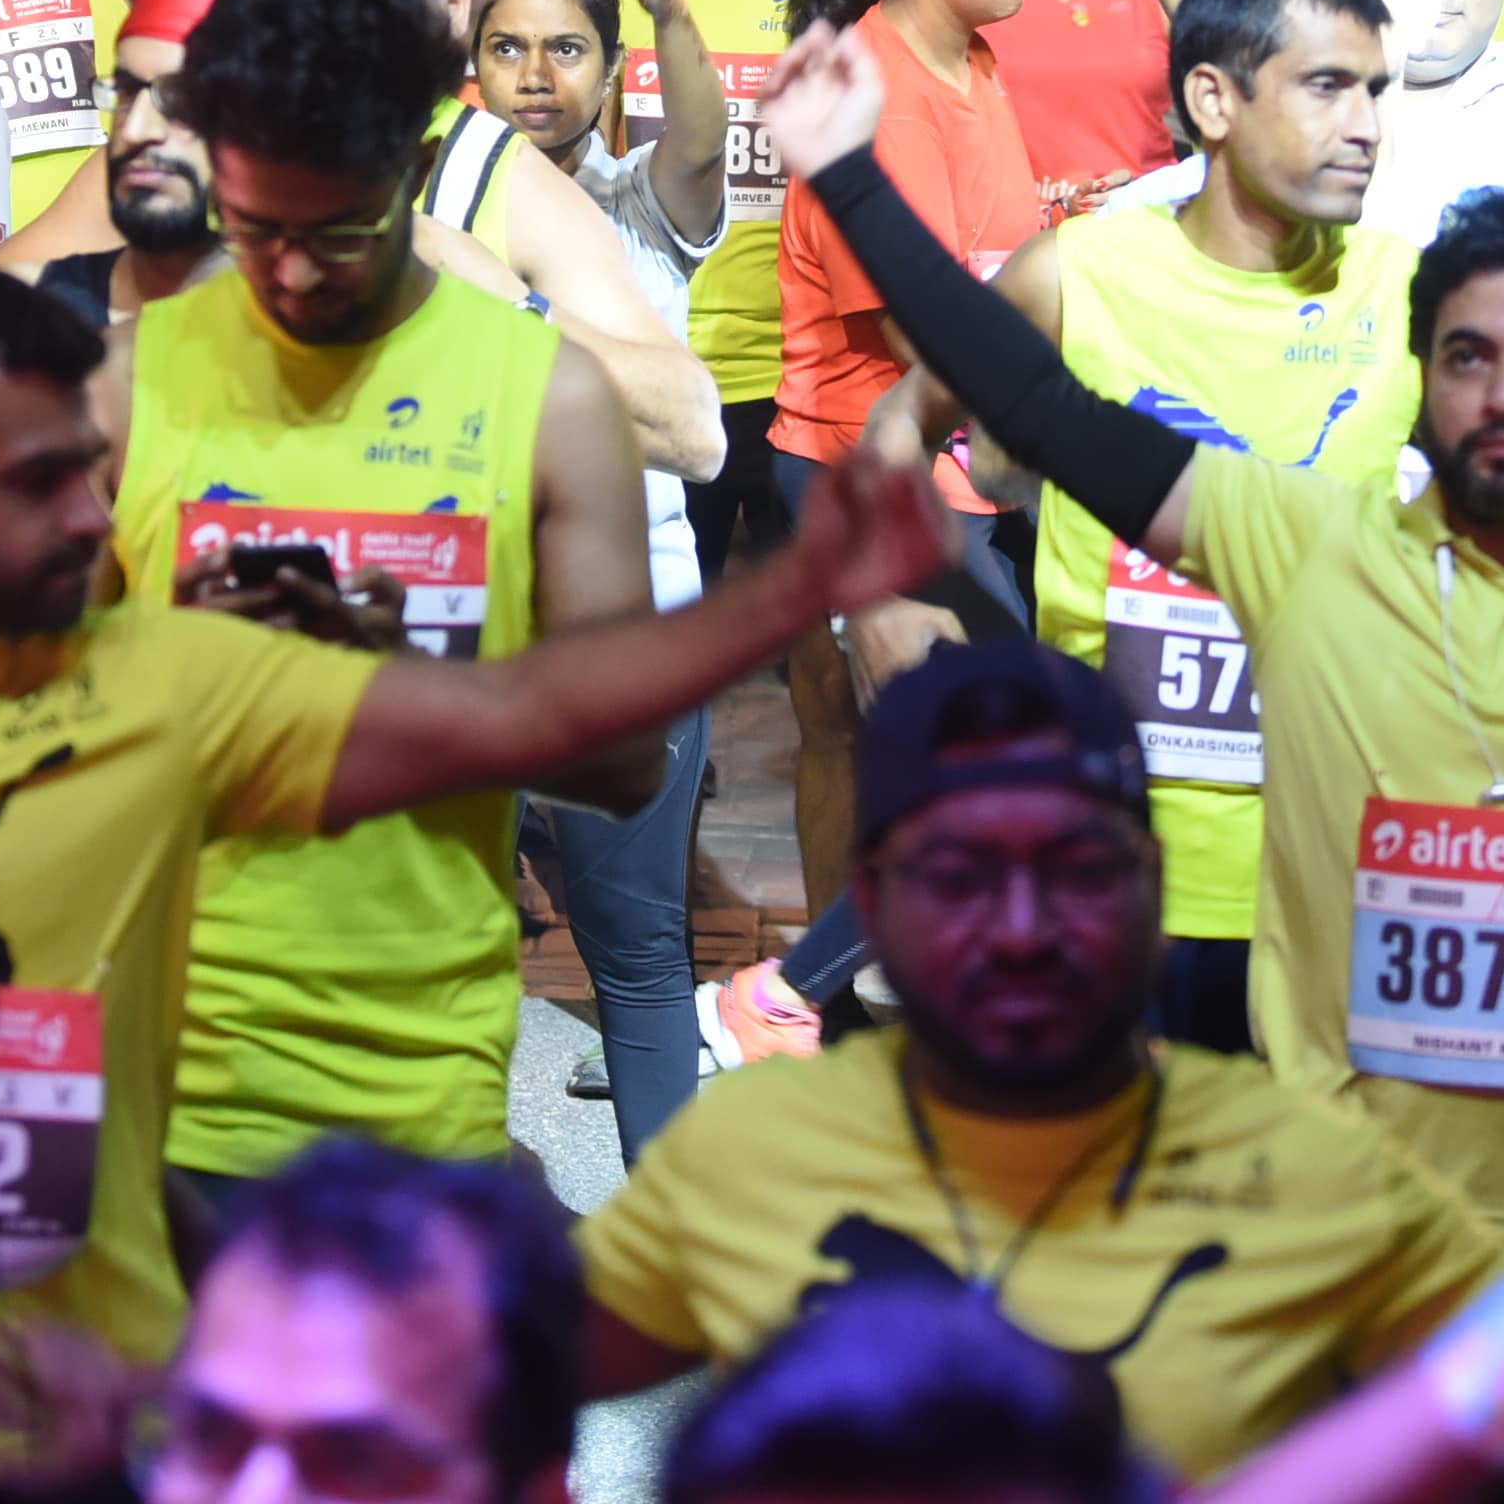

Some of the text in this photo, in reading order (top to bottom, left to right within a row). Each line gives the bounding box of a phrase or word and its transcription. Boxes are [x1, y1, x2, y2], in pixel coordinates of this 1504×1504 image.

[8, 30, 22, 48] F
[73, 22, 84, 36] V
[22, 118, 70, 135] MEWANI
[1283, 338, 1338, 364] airtel
[363, 439, 432, 467] airtel
[445, 592, 464, 615] V
[1158, 634, 1262, 715] 57
